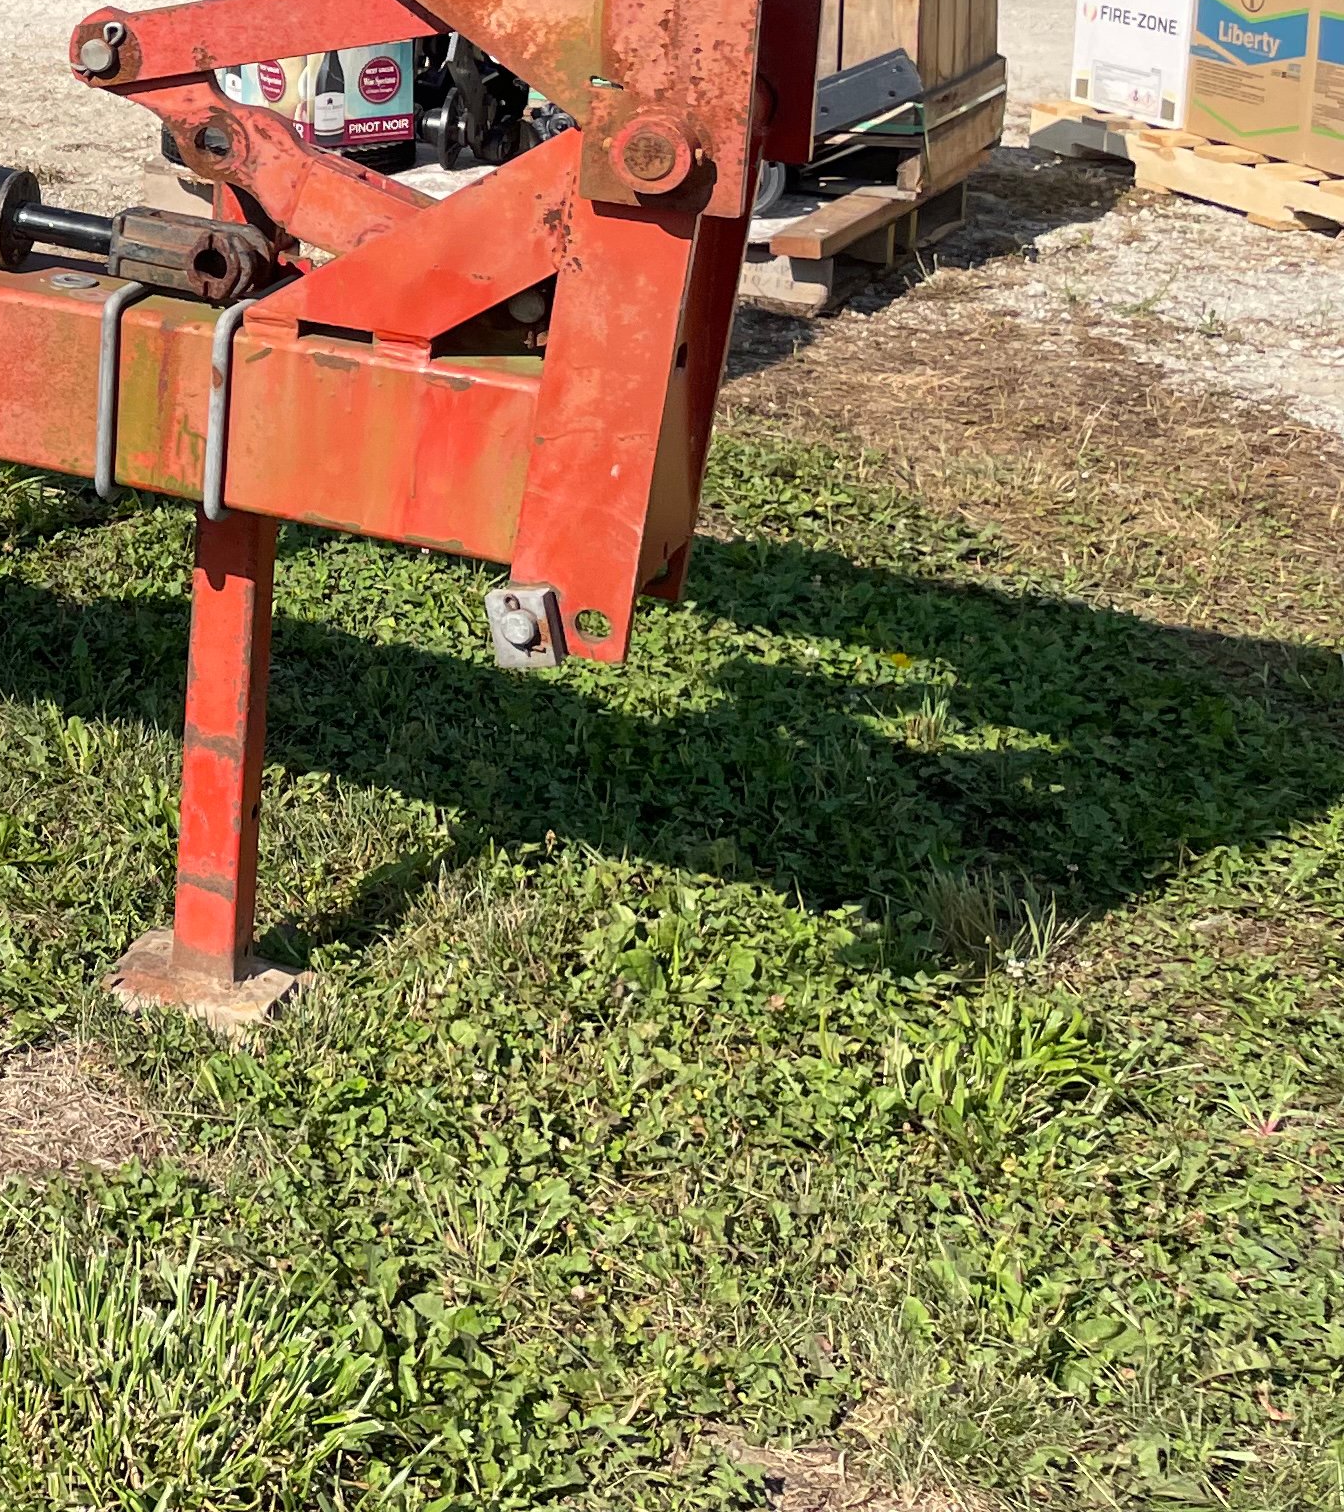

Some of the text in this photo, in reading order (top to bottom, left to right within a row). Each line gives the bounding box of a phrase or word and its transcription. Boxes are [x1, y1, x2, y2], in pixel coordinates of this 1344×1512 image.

[1100, 5, 1178, 35] FIRE-ZONE
[1218, 20, 1281, 58] Liberty
[348, 121, 381, 135] PINOT
[383, 118, 409, 131] NOIR
